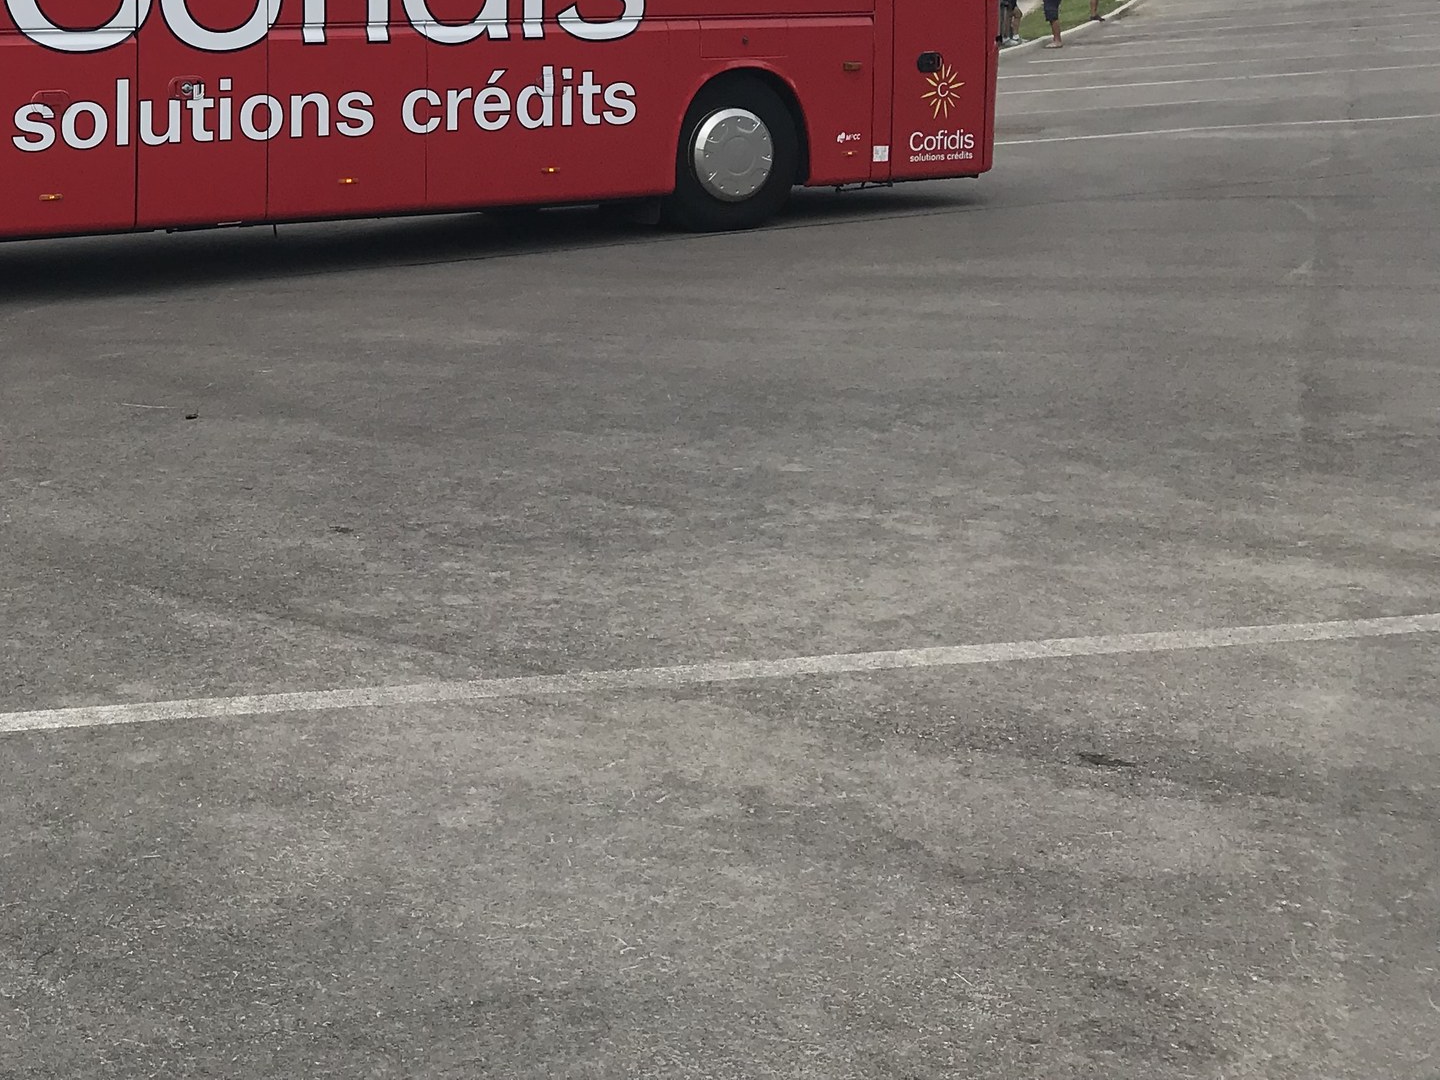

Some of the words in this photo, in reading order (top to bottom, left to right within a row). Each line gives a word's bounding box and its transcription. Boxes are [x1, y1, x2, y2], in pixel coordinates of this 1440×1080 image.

[11, 77, 376, 152] solutions
[400, 65, 638, 134] crédits
[909, 128, 975, 151] Cofidis
[909, 153, 946, 162] solutions
[946, 150, 973, 160] crédits
